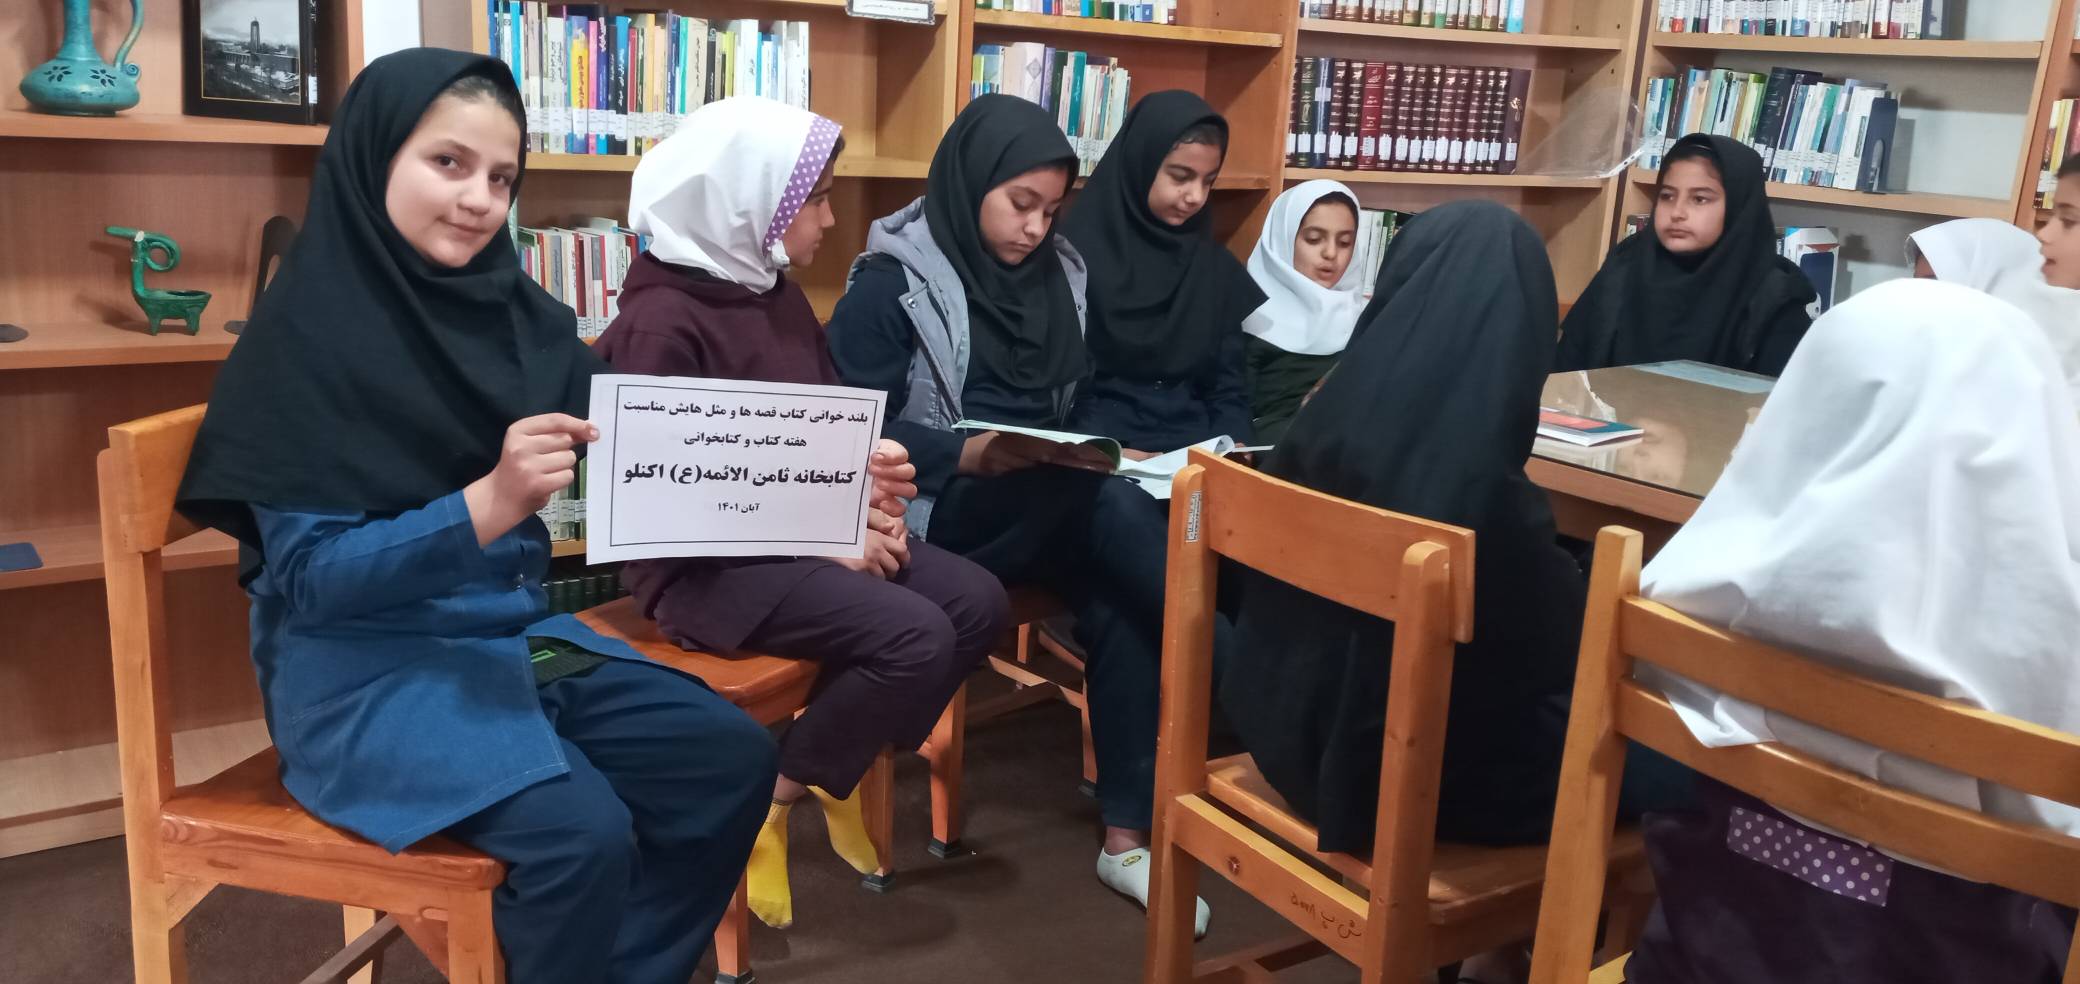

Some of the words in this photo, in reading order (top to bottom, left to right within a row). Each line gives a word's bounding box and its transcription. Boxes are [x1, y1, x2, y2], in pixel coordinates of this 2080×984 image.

[623, 400, 667, 414] مناسبت
[668, 401, 703, 416] هایش
[704, 403, 727, 418] مثل
[728, 409, 737, 420] و
[738, 405, 752, 417] ها
[753, 406, 777, 418] قصه
[779, 407, 808, 422] کتاب
[808, 409, 845, 425] خوانی
[847, 411, 869, 426] بلند
[683, 431, 742, 447] کتابخوانی
[743, 438, 751, 449] و
[752, 434, 782, 449] کتاب
[783, 436, 808, 448] هفته
[622, 461, 665, 484] اکنلو
[751, 466, 791, 487] ثامن
[792, 468, 858, 488] کتابخانه
[717, 501, 741, 512] ۱۴۰۱
[740, 502, 761, 514] آبان
